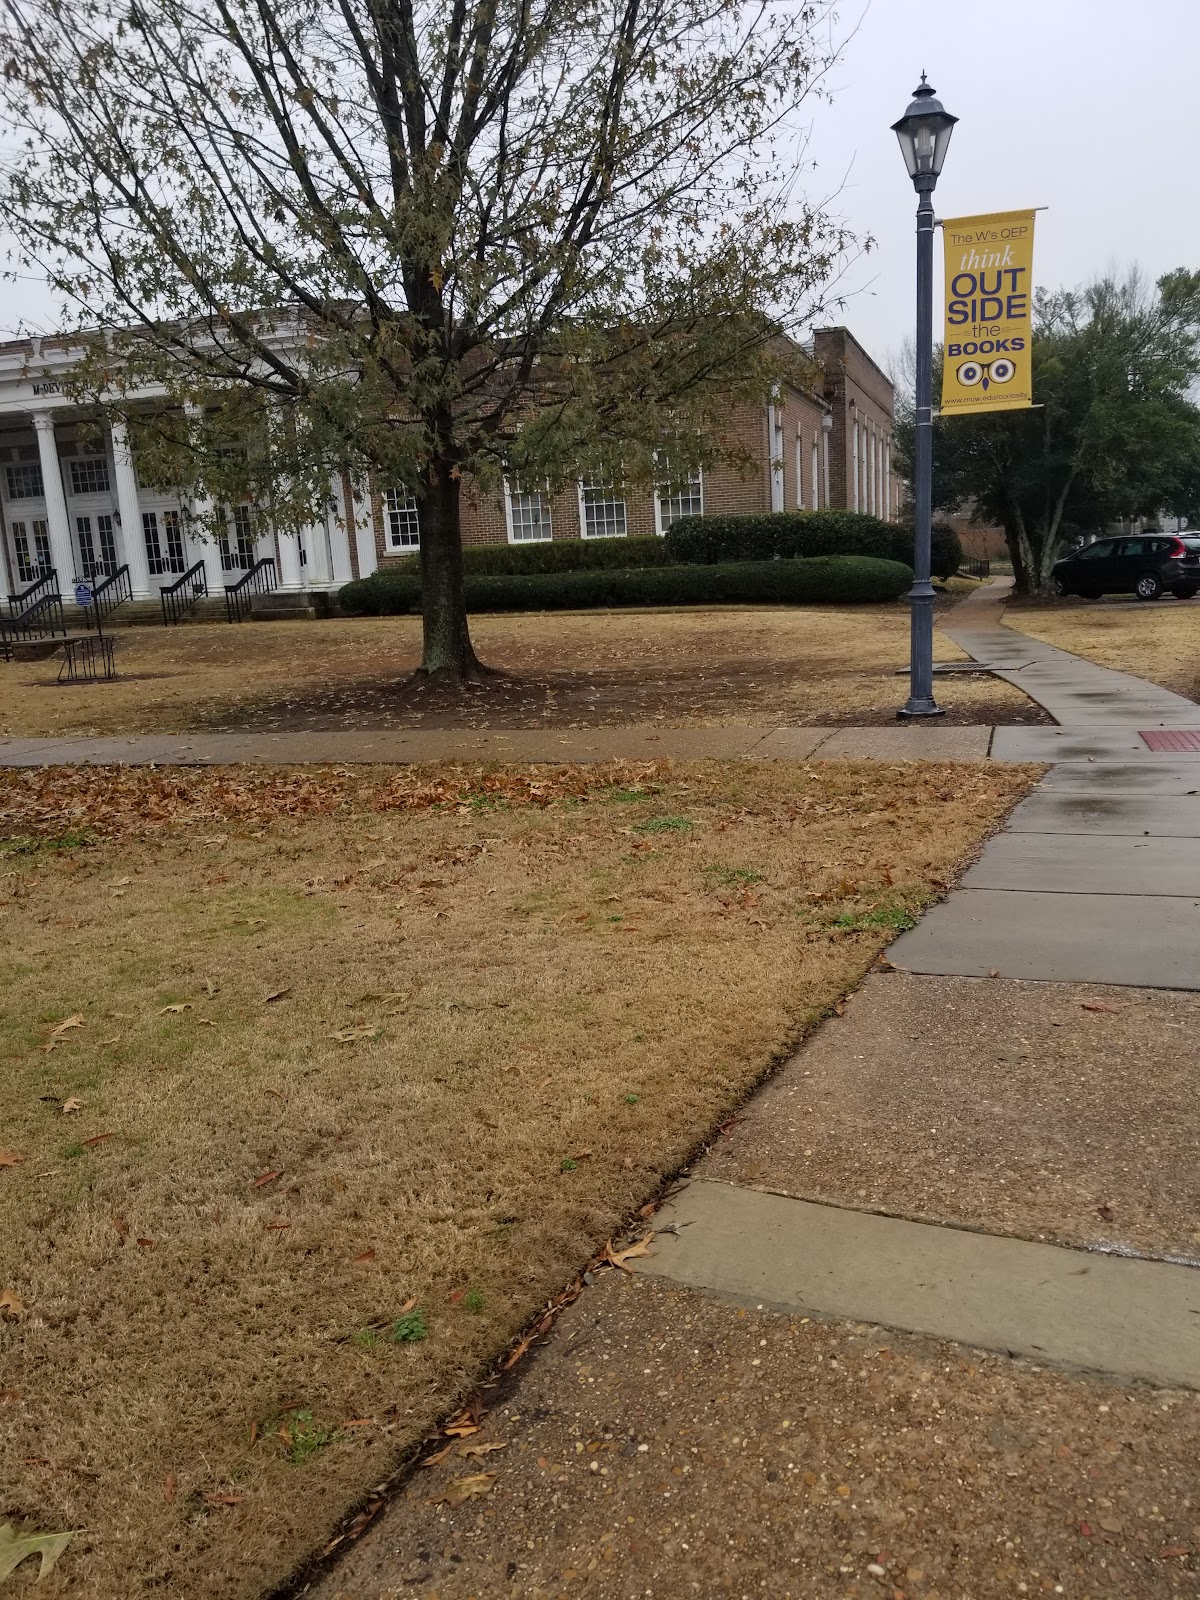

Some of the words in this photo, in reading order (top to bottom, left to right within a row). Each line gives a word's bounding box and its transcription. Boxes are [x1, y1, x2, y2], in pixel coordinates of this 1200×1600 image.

[951, 232, 972, 245] The
[976, 230, 998, 242] W's
[1001, 227, 1028, 239] QEP
[960, 245, 1015, 271] think
[951, 268, 1026, 298] OUT
[947, 294, 1027, 324] SIDE
[971, 324, 1001, 338] the
[948, 337, 1025, 357] BOOKS
[944, 392, 1028, 404] www.muw.edu/curiosity
